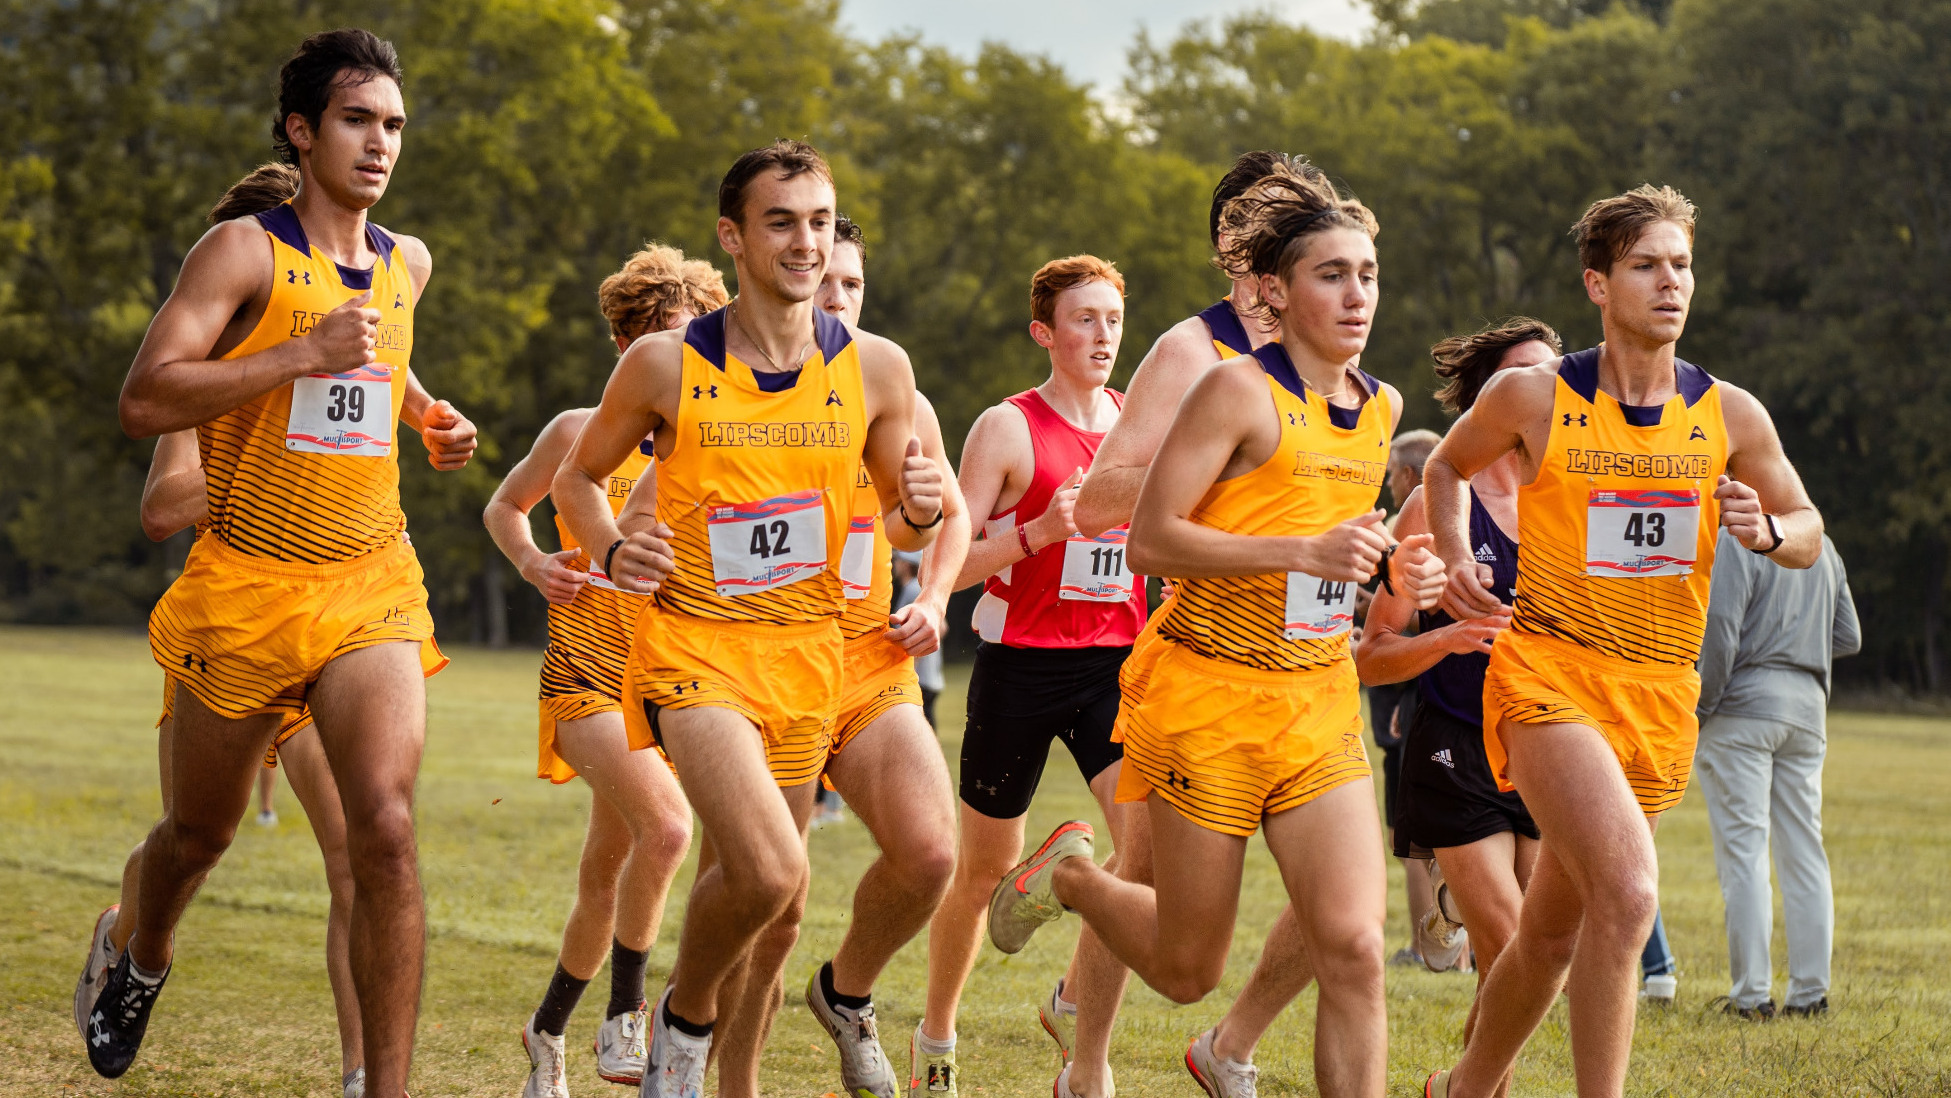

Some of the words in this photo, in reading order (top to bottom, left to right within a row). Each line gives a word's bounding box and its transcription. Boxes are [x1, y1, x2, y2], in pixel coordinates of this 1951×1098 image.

[327, 384, 365, 423] 39
[699, 422, 850, 447] LIPSCOMB
[1293, 451, 1388, 488] LIPSCOM
[1567, 449, 1712, 478] LIPSCOMB
[750, 519, 791, 559] 42
[1624, 512, 1666, 547] 43
[1090, 547, 1123, 577] 111
[1317, 578, 1347, 606] 44
[1431, 755, 1455, 768] adidas
